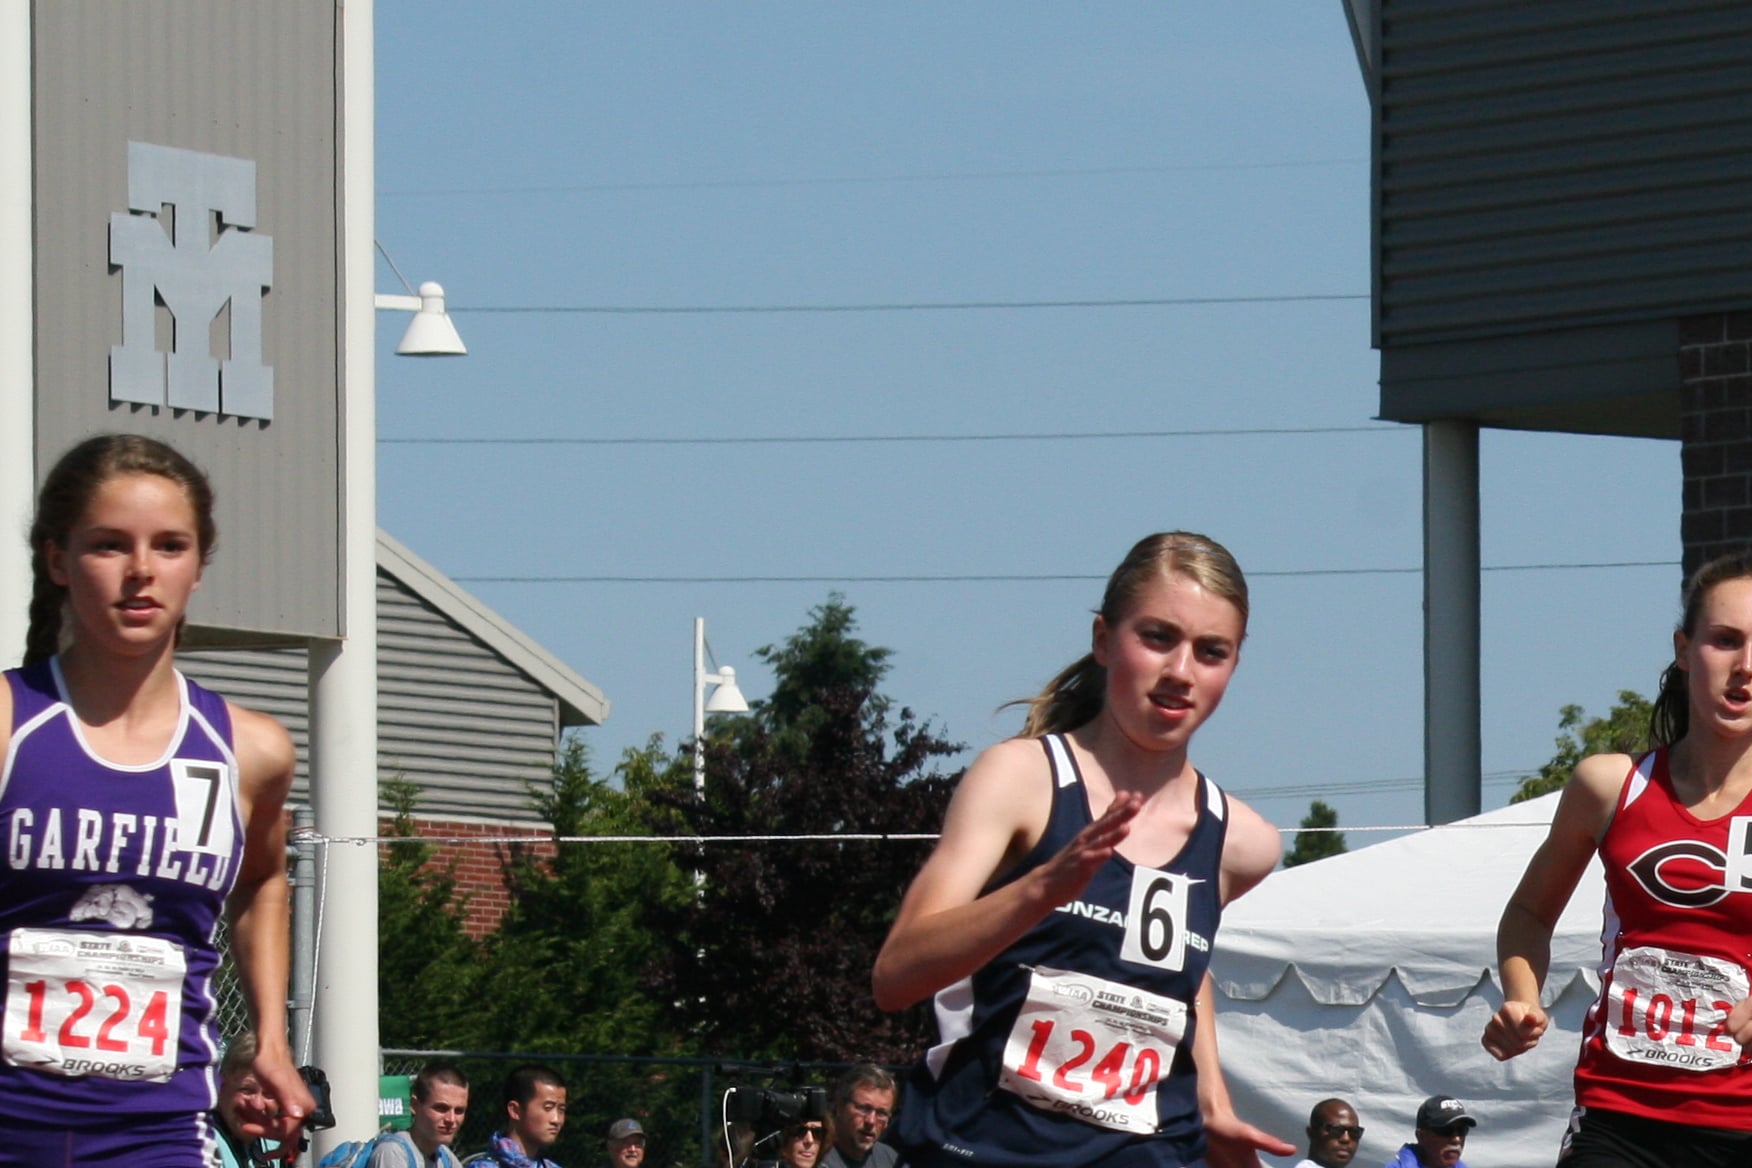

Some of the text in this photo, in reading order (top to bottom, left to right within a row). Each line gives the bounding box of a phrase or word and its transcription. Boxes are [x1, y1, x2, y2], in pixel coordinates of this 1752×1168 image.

[185, 766, 221, 848] 7
[1140, 877, 1174, 962] 6
[1184, 930, 1209, 952] REP
[1096, 990, 1127, 1005] STATE
[20, 979, 169, 1057] 1224
[1091, 1000, 1169, 1027] CHAMPIONSHIPS
[1616, 987, 1734, 1053] 1012
[62, 1059, 147, 1078] BROOKS
[1017, 1020, 1160, 1106] 1240
[1644, 1049, 1714, 1068] BROOKS
[1053, 1099, 1130, 1126] BROOKS
